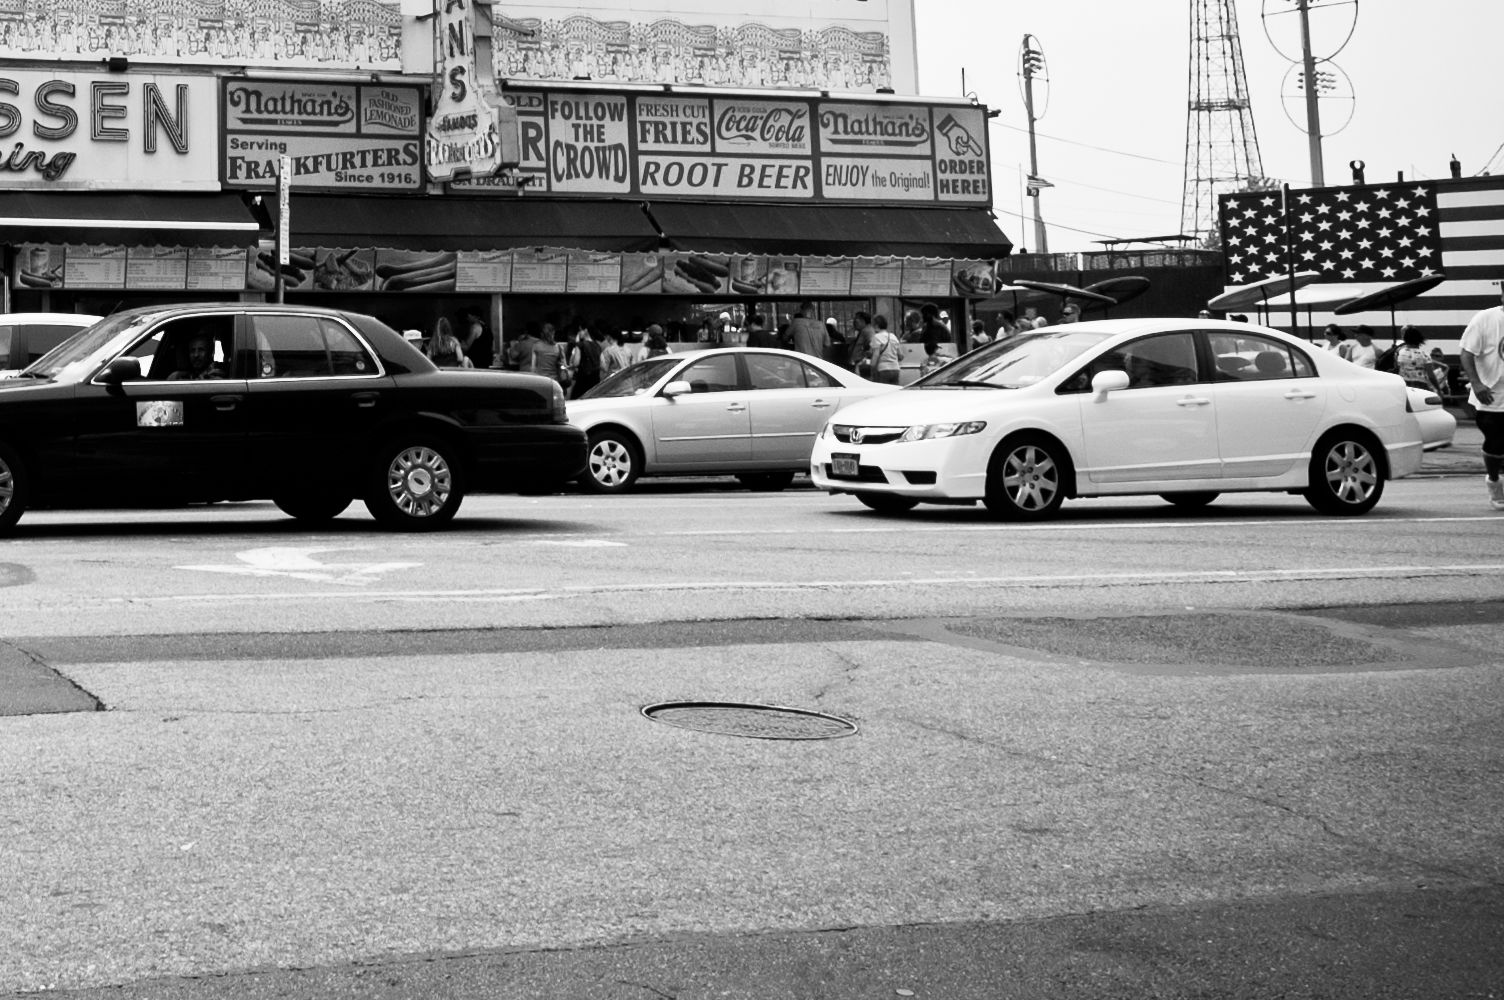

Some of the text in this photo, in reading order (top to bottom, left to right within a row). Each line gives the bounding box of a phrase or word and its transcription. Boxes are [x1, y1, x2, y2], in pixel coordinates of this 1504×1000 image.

[380, 89, 399, 103] OLD
[368, 97, 412, 116] FASHIONED
[549, 100, 626, 122] FOLLOW
[638, 103, 709, 119] FRESH CUT
[364, 107, 417, 129] LEMONADE
[571, 122, 607, 144] THE
[639, 121, 710, 146] FRIES
[229, 137, 288, 153] Serving
[552, 140, 629, 185] CROWD
[938, 159, 986, 176] ORDER
[334, 171, 418, 185] Since 1916.
[640, 161, 812, 192] ROOT BEER
[824, 164, 931, 193] ENJOY the Original!
[939, 178, 988, 196] HERE!
